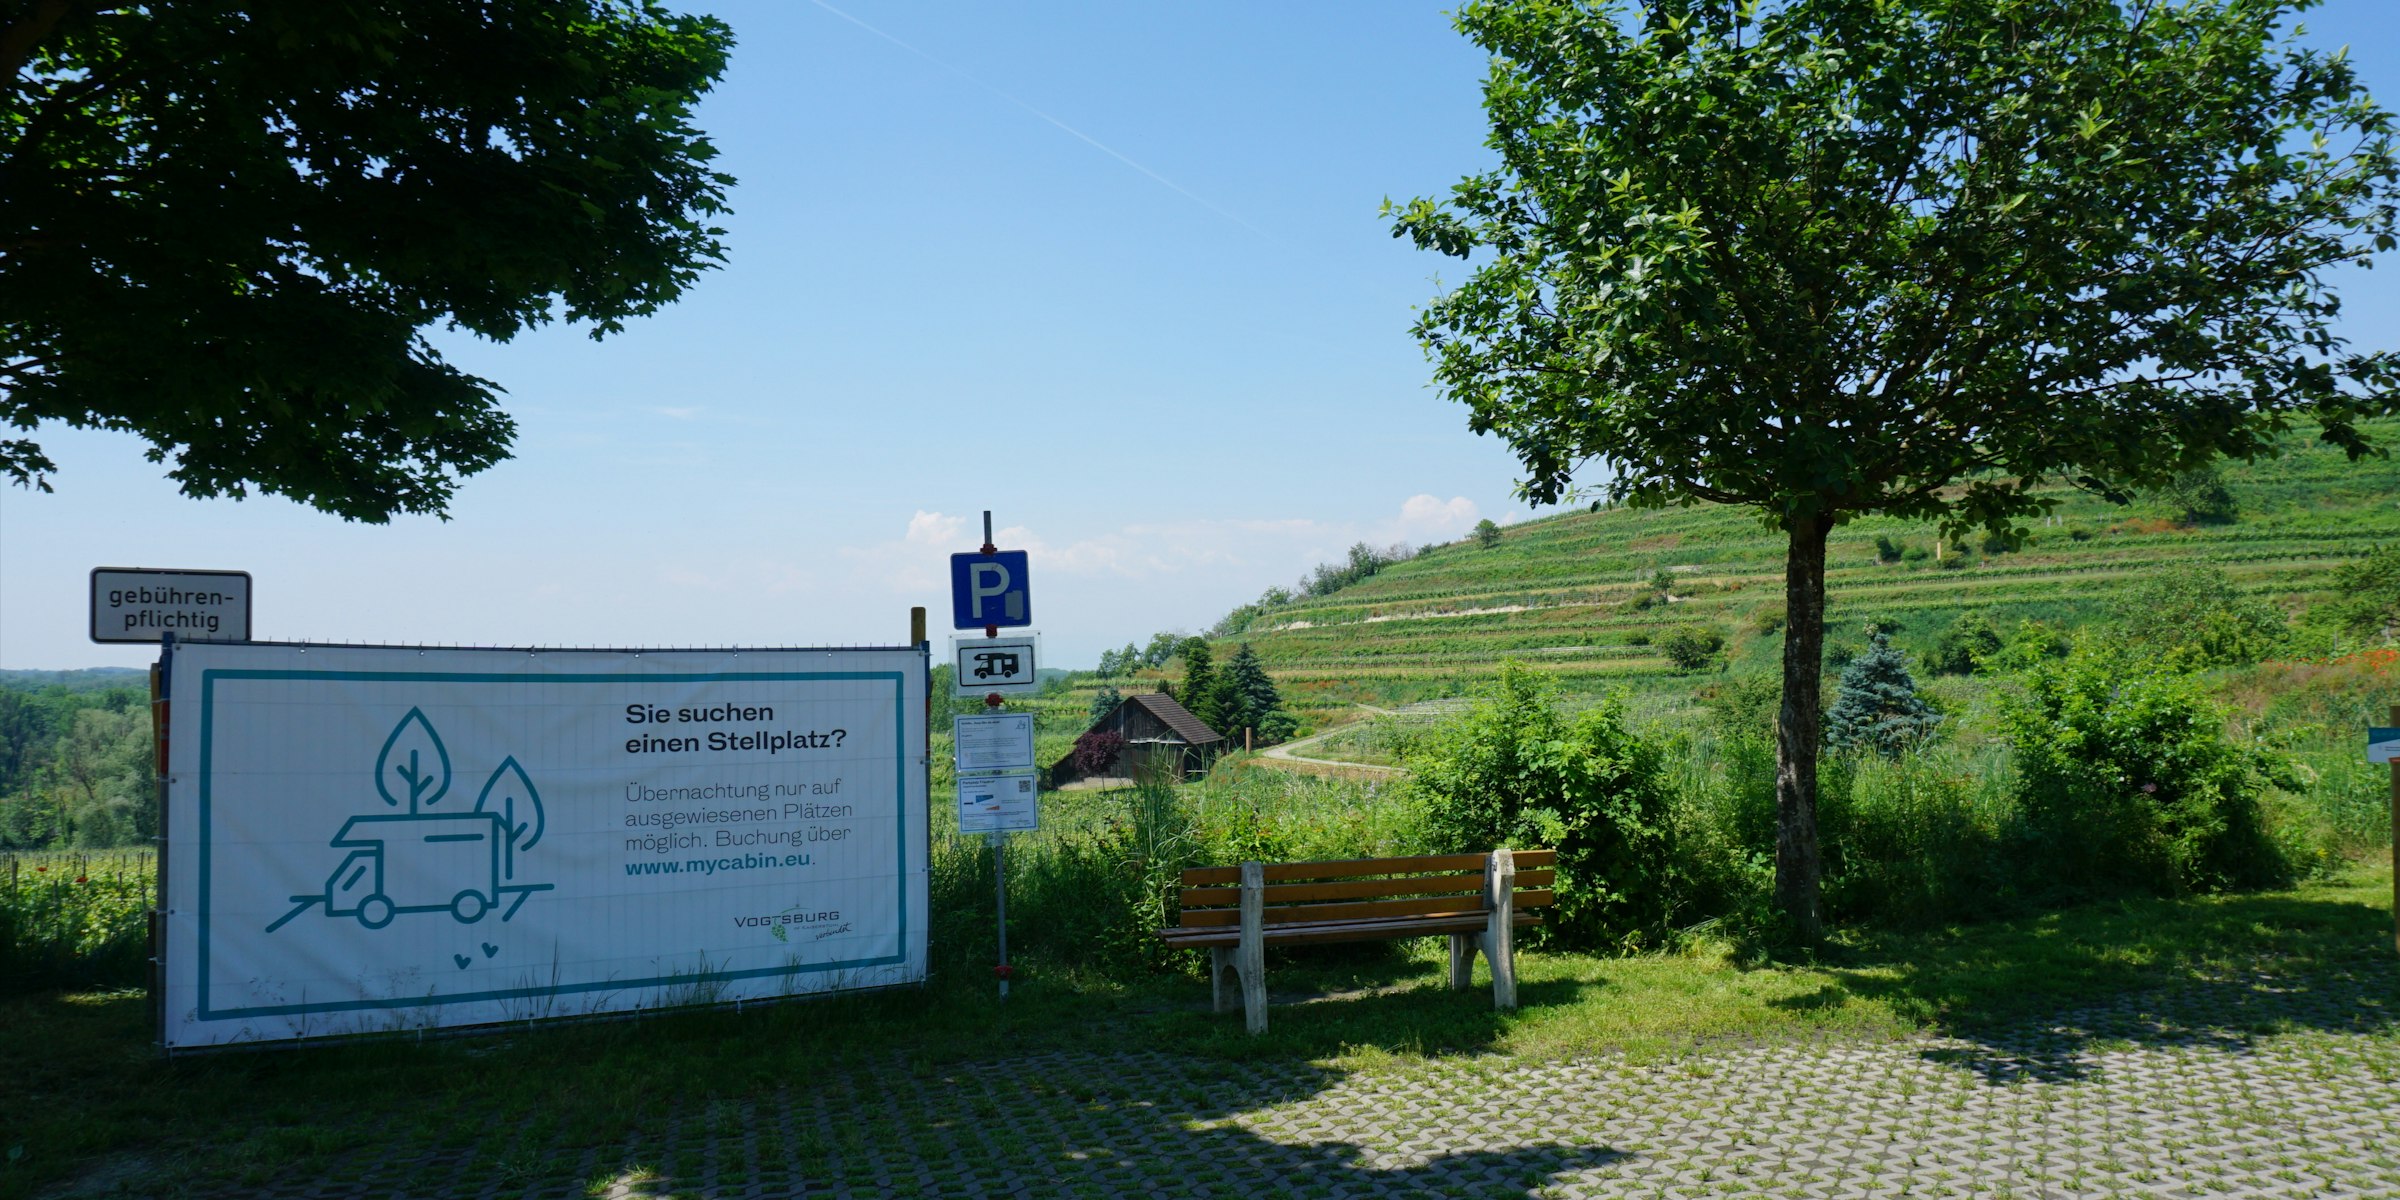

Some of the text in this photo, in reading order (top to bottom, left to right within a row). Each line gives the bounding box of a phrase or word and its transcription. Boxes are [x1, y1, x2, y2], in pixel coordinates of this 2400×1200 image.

[109, 586, 234, 608] gebühren-
[970, 562, 1010, 618] P
[124, 610, 220, 632] pflichtig
[625, 703, 774, 724] Sie suchen
[625, 729, 847, 755] einen Stellplatz?
[625, 778, 842, 802] Übernachtung nur auf
[625, 803, 853, 830] ausgewiesenen Plätzen
[625, 826, 851, 854] möglich. Buchung über
[625, 853, 816, 876] www.mycabin.eu.
[734, 911, 840, 928] VOGTSBURG
